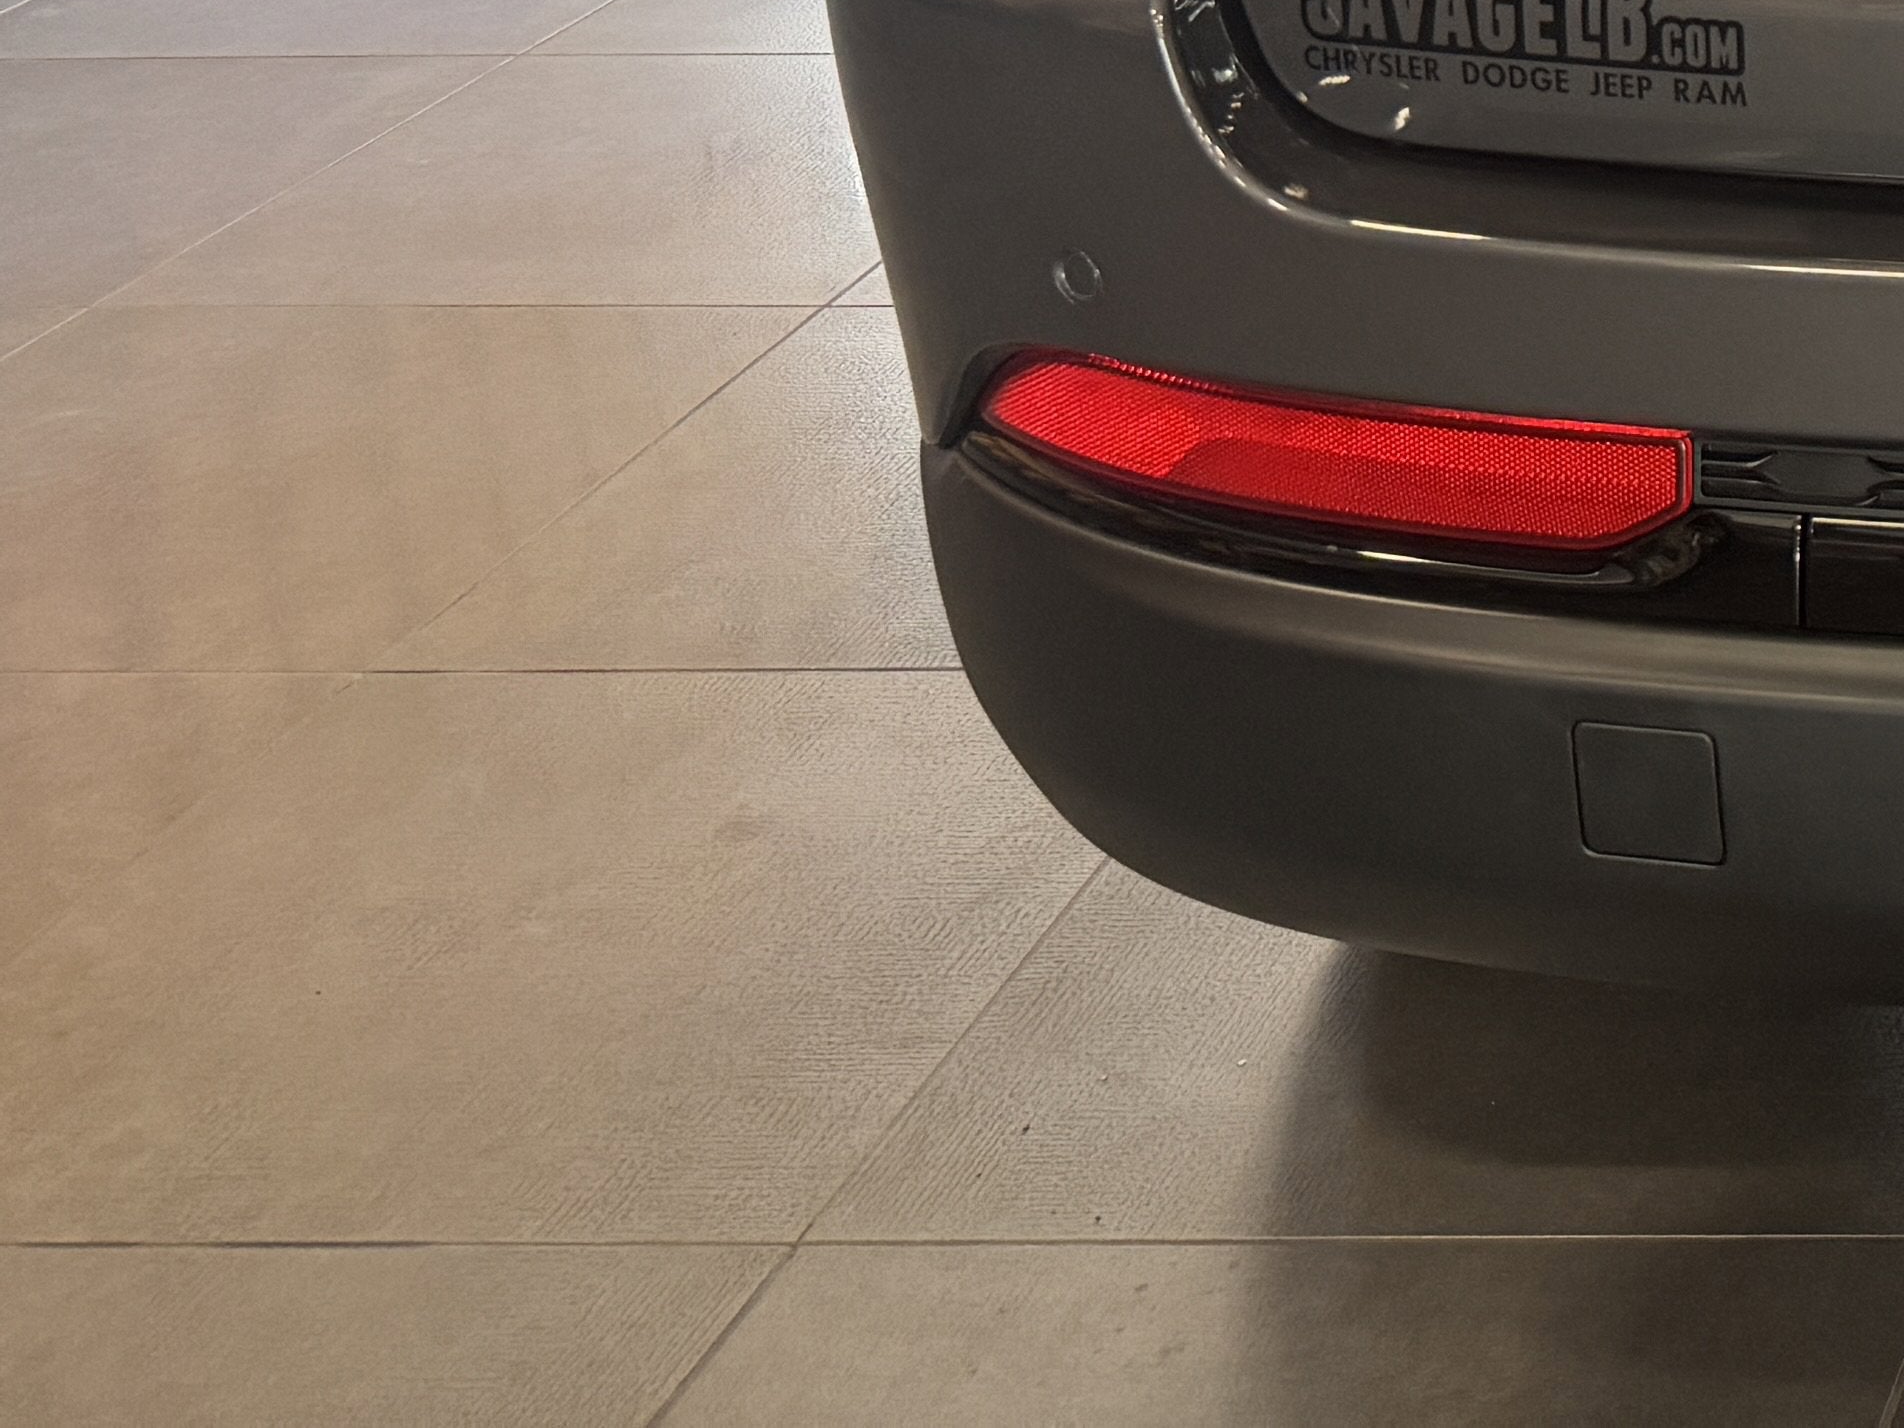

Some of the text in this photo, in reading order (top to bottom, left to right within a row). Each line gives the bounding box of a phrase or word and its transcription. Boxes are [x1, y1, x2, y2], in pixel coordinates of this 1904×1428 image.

[1304, 45, 1748, 108] CHRYSLER DODGE JEEP RAM
